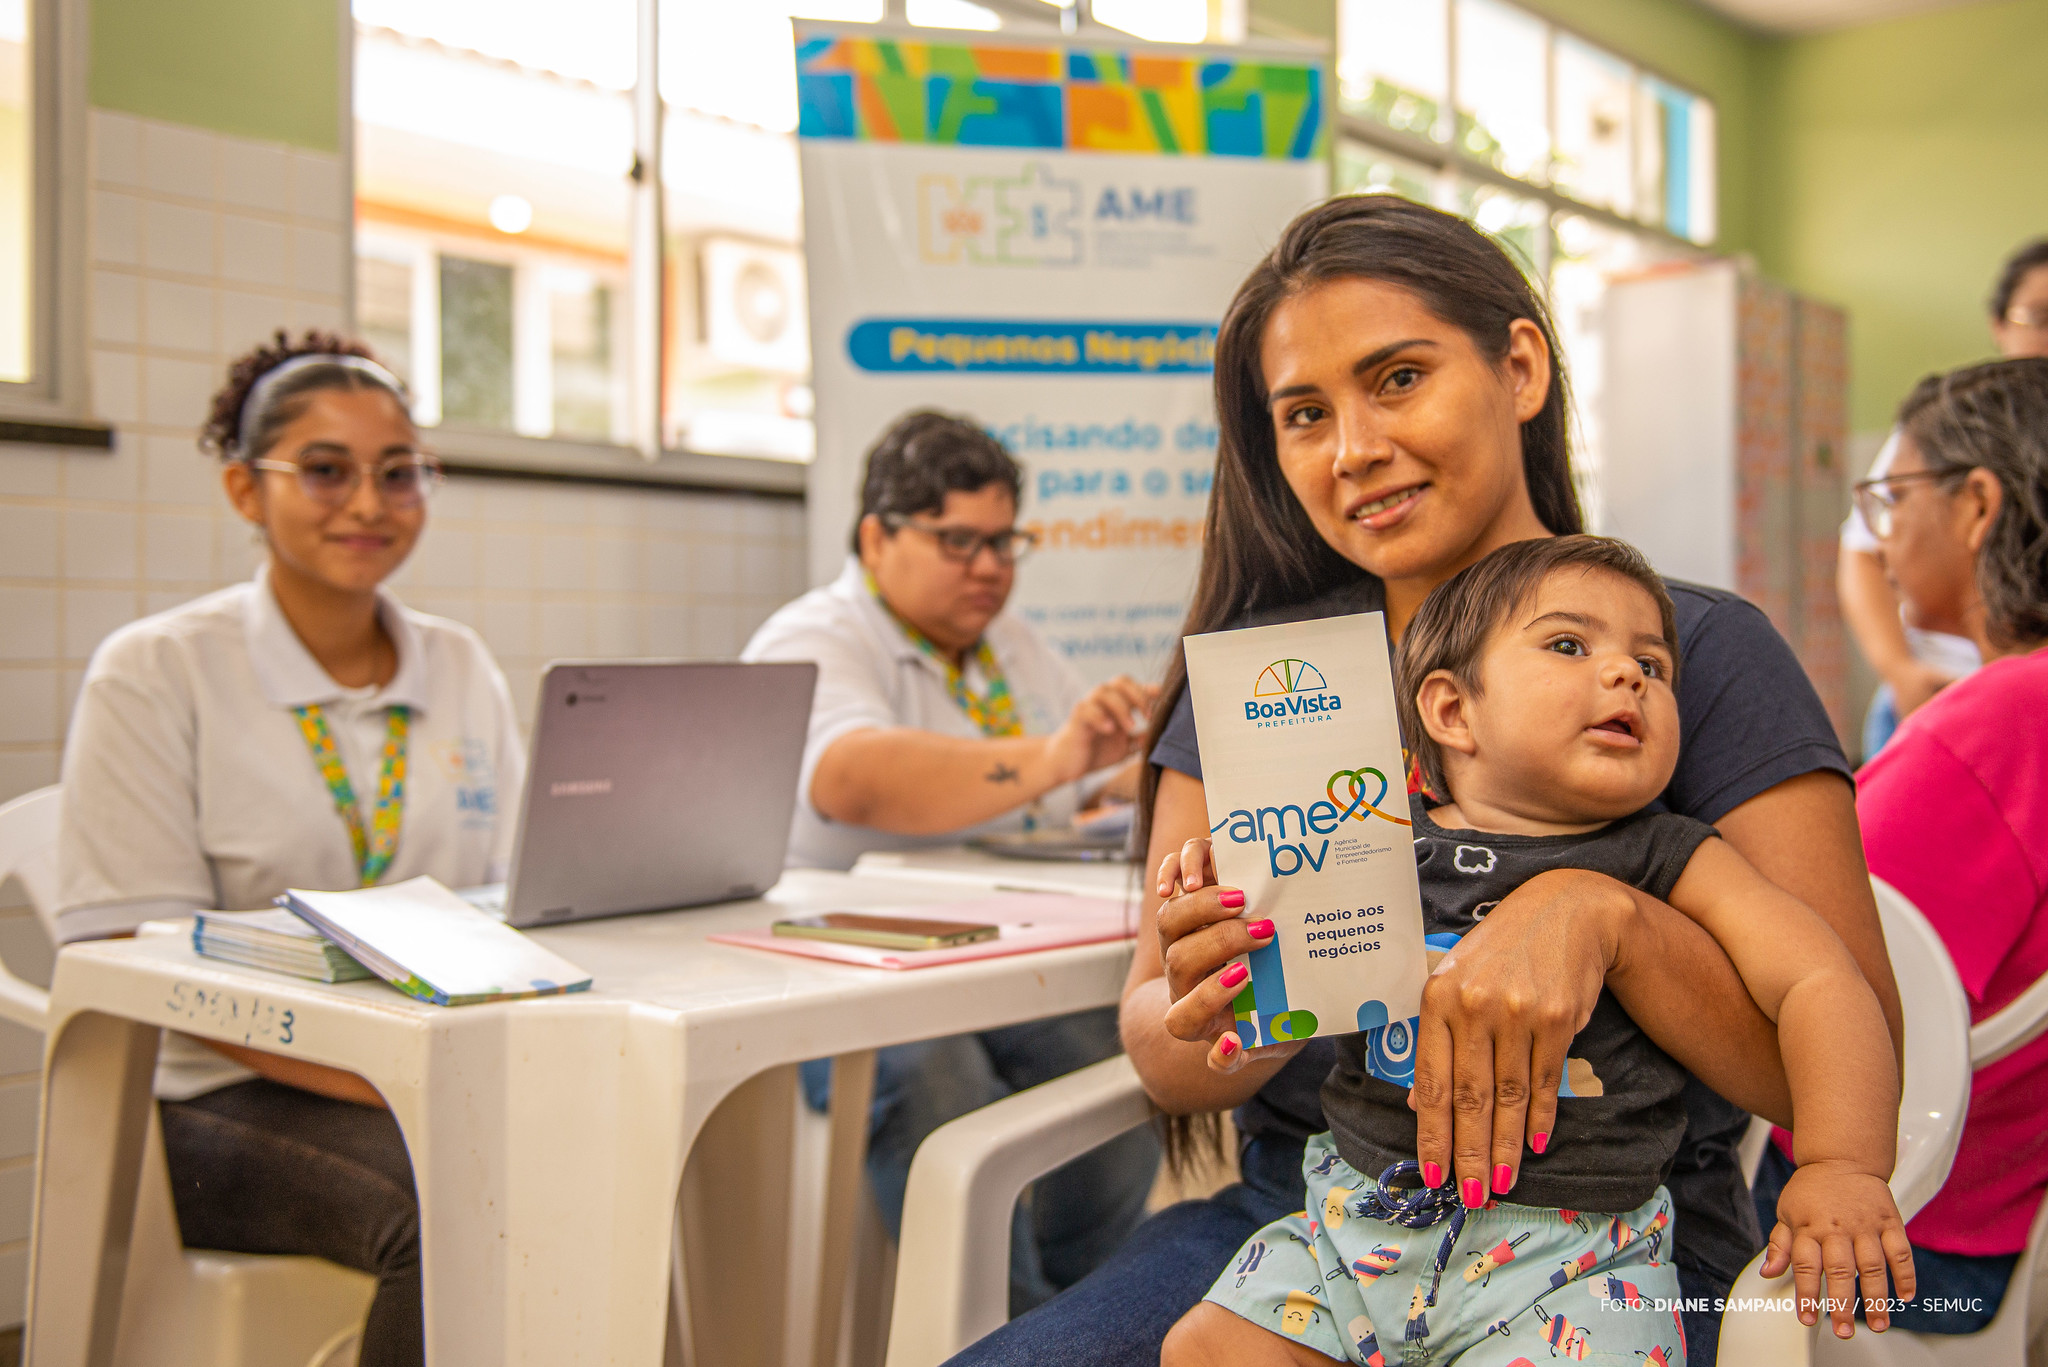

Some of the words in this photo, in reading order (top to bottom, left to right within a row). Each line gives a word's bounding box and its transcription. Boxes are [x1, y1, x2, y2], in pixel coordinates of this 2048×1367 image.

[1095, 186, 1197, 223] AME
[889, 327, 1079, 368] Pequenos
[1038, 469, 1131, 504] para
[1143, 469, 1170, 496] o
[1257, 714, 1332, 728] PREFEITURA
[1229, 800, 1339, 844] ame
[1334, 838, 1358, 846] Agência
[1334, 844, 1362, 852] Municipal
[1335, 846, 1392, 860] Empreendedorismo
[1267, 833, 1330, 878] bv
[1341, 857, 1368, 865] Fomento
[1304, 909, 1352, 926] Apoio
[1357, 904, 1385, 918] aos
[1306, 921, 1385, 943] pequenos
[1308, 939, 1381, 959] negócios
